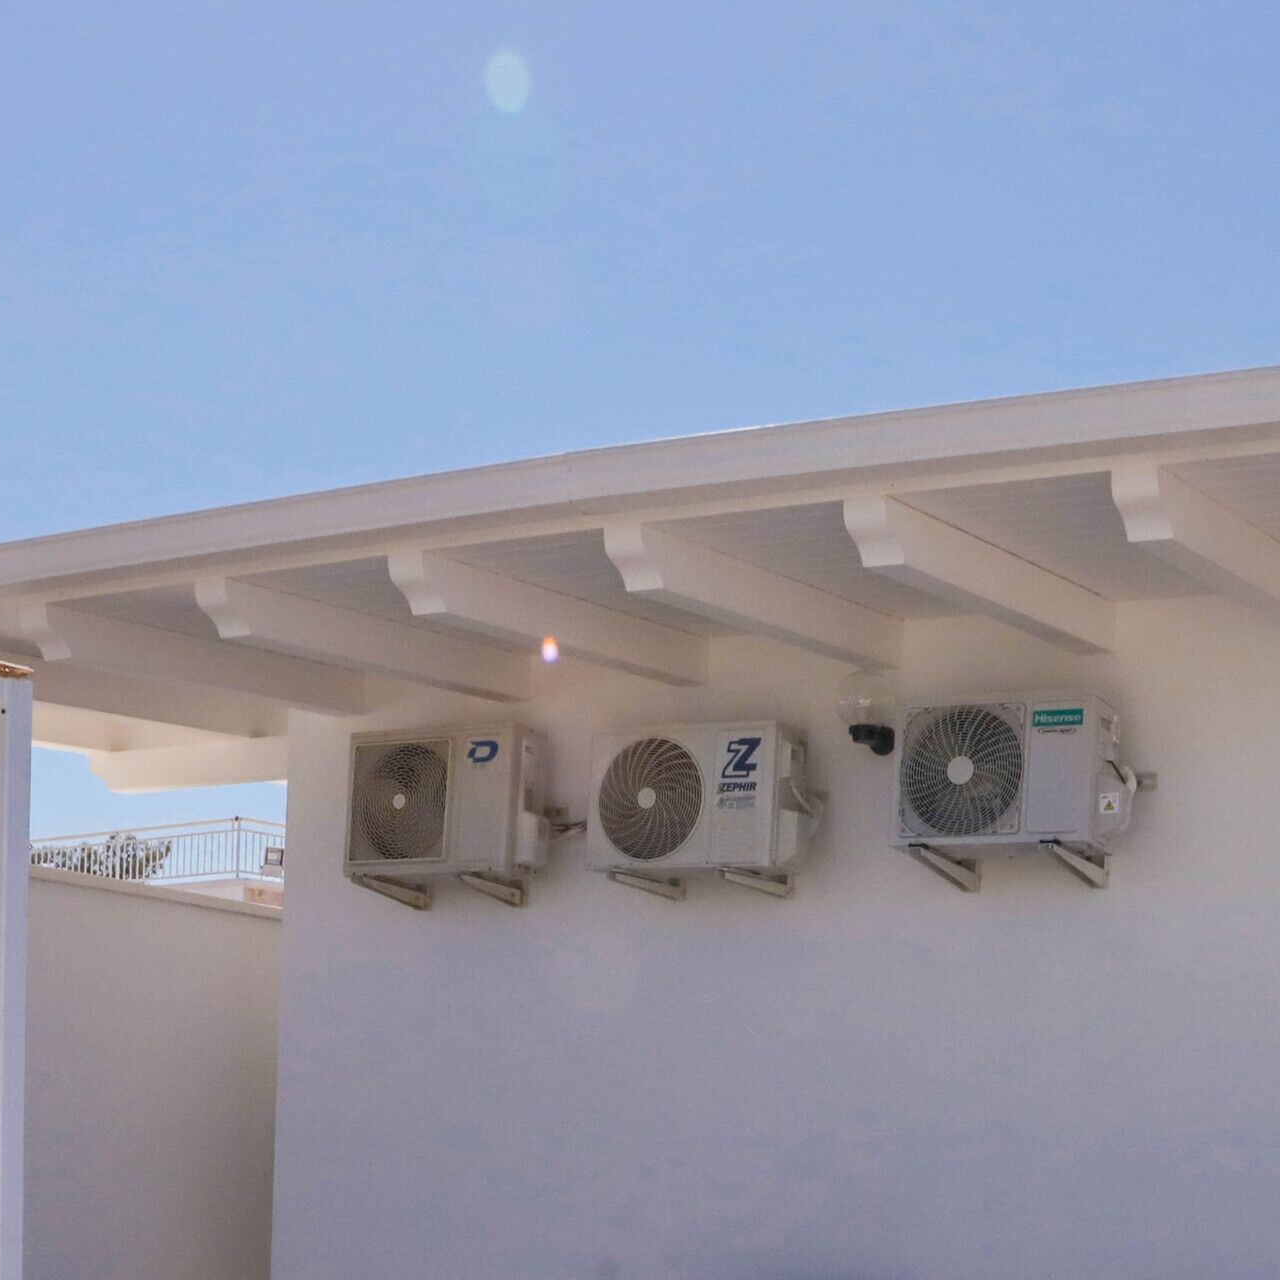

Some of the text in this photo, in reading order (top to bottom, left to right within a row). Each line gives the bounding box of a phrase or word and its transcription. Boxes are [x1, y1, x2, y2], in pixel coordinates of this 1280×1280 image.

[1034, 713, 1081, 723] Hisense
[722, 737, 762, 778] Z
[719, 782, 757, 793] ZEPHIR
